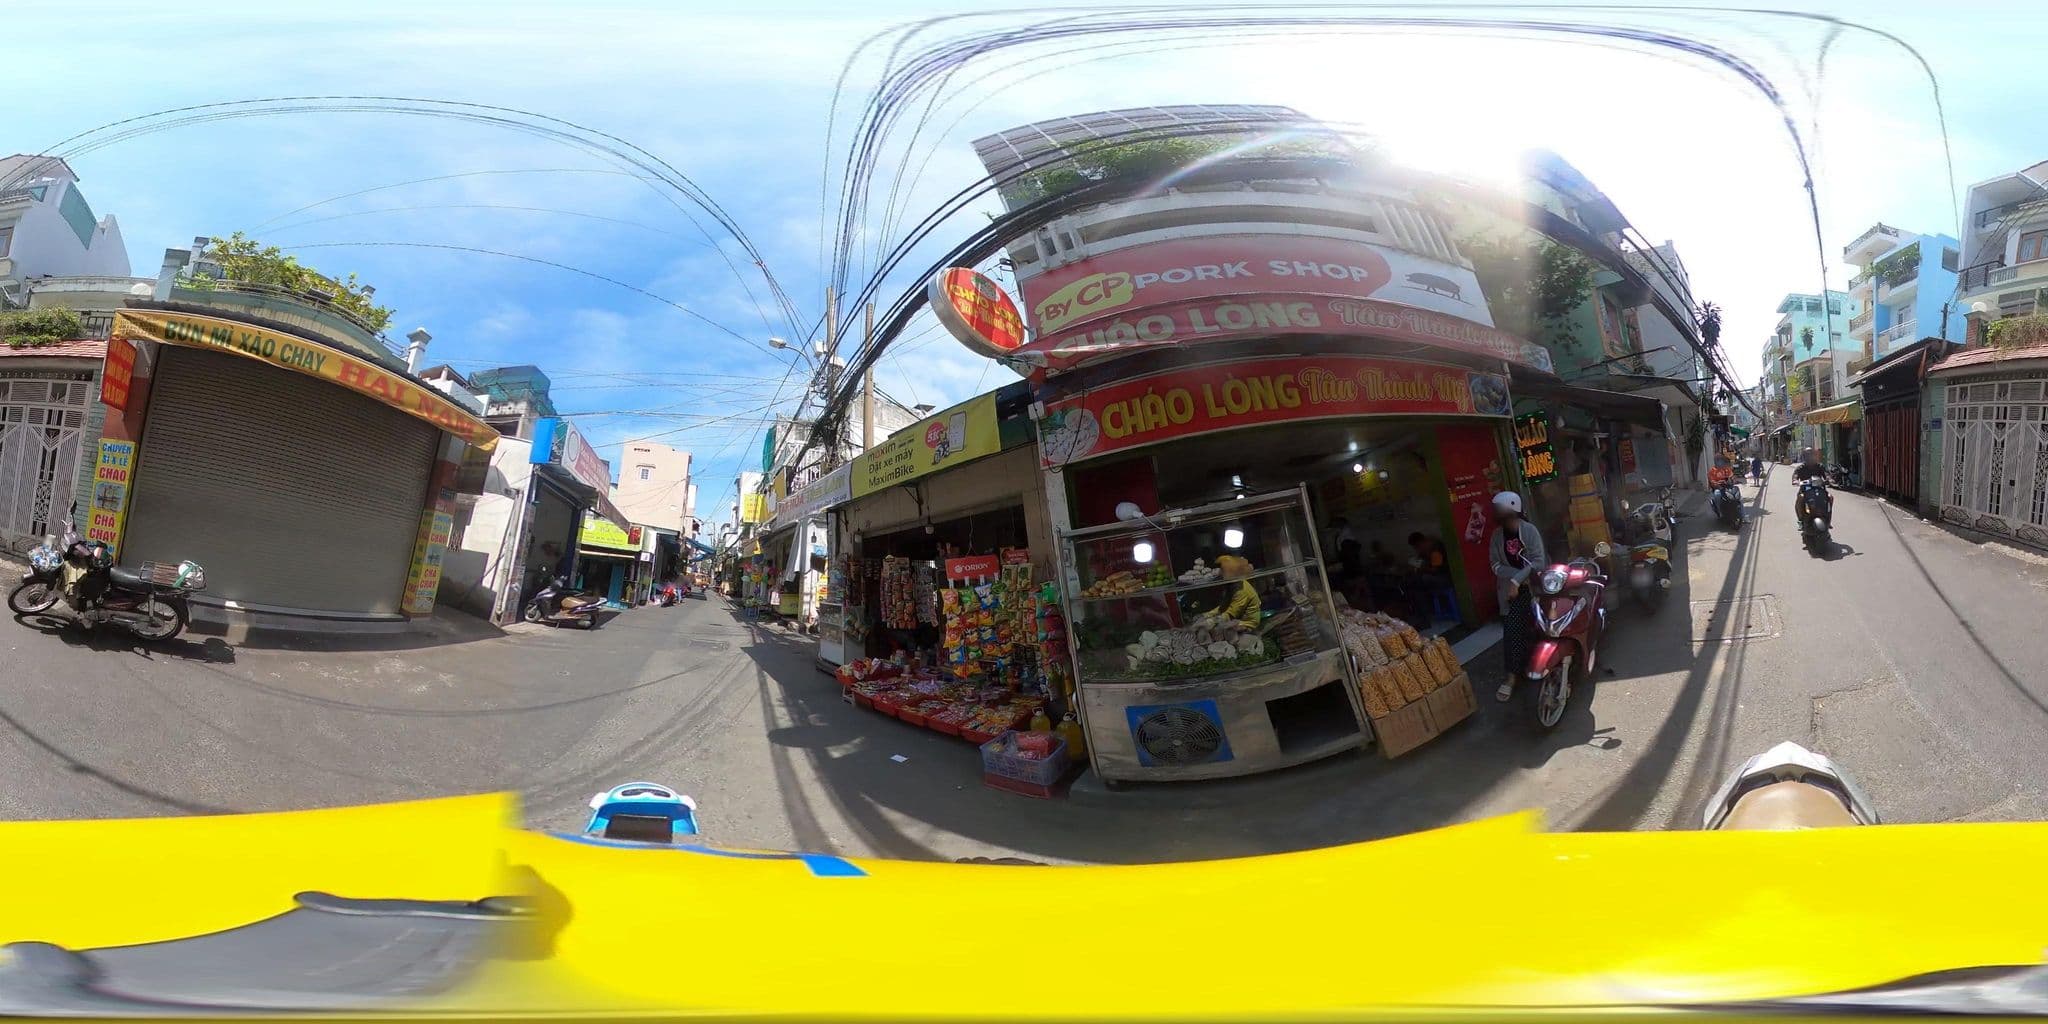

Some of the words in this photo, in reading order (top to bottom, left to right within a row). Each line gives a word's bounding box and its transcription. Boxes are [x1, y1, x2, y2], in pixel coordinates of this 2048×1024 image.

[1134, 262, 1256, 289] PORK
[1268, 260, 1368, 283] SHOP
[1077, 276, 1123, 306] CP
[1189, 299, 1321, 334] LÒNG
[164, 319, 205, 344] BÚN
[210, 325, 232, 348] MÌ
[239, 331, 276, 358] XÀO
[279, 343, 326, 372] CHAY
[1102, 387, 1194, 439] CHÁO
[1202, 373, 1300, 418] LÒNG
[1300, 367, 1357, 404] Tân
[867, 442, 896, 462] maxim
[883, 458, 894, 468] xe
[895, 447, 914, 466] máy
[1523, 449, 1554, 478] LÒNG
[99, 467, 126, 481] CHAO
[868, 464, 915, 489] MaximBike
[89, 527, 117, 543] CHAY
[964, 562, 990, 572] ORION
